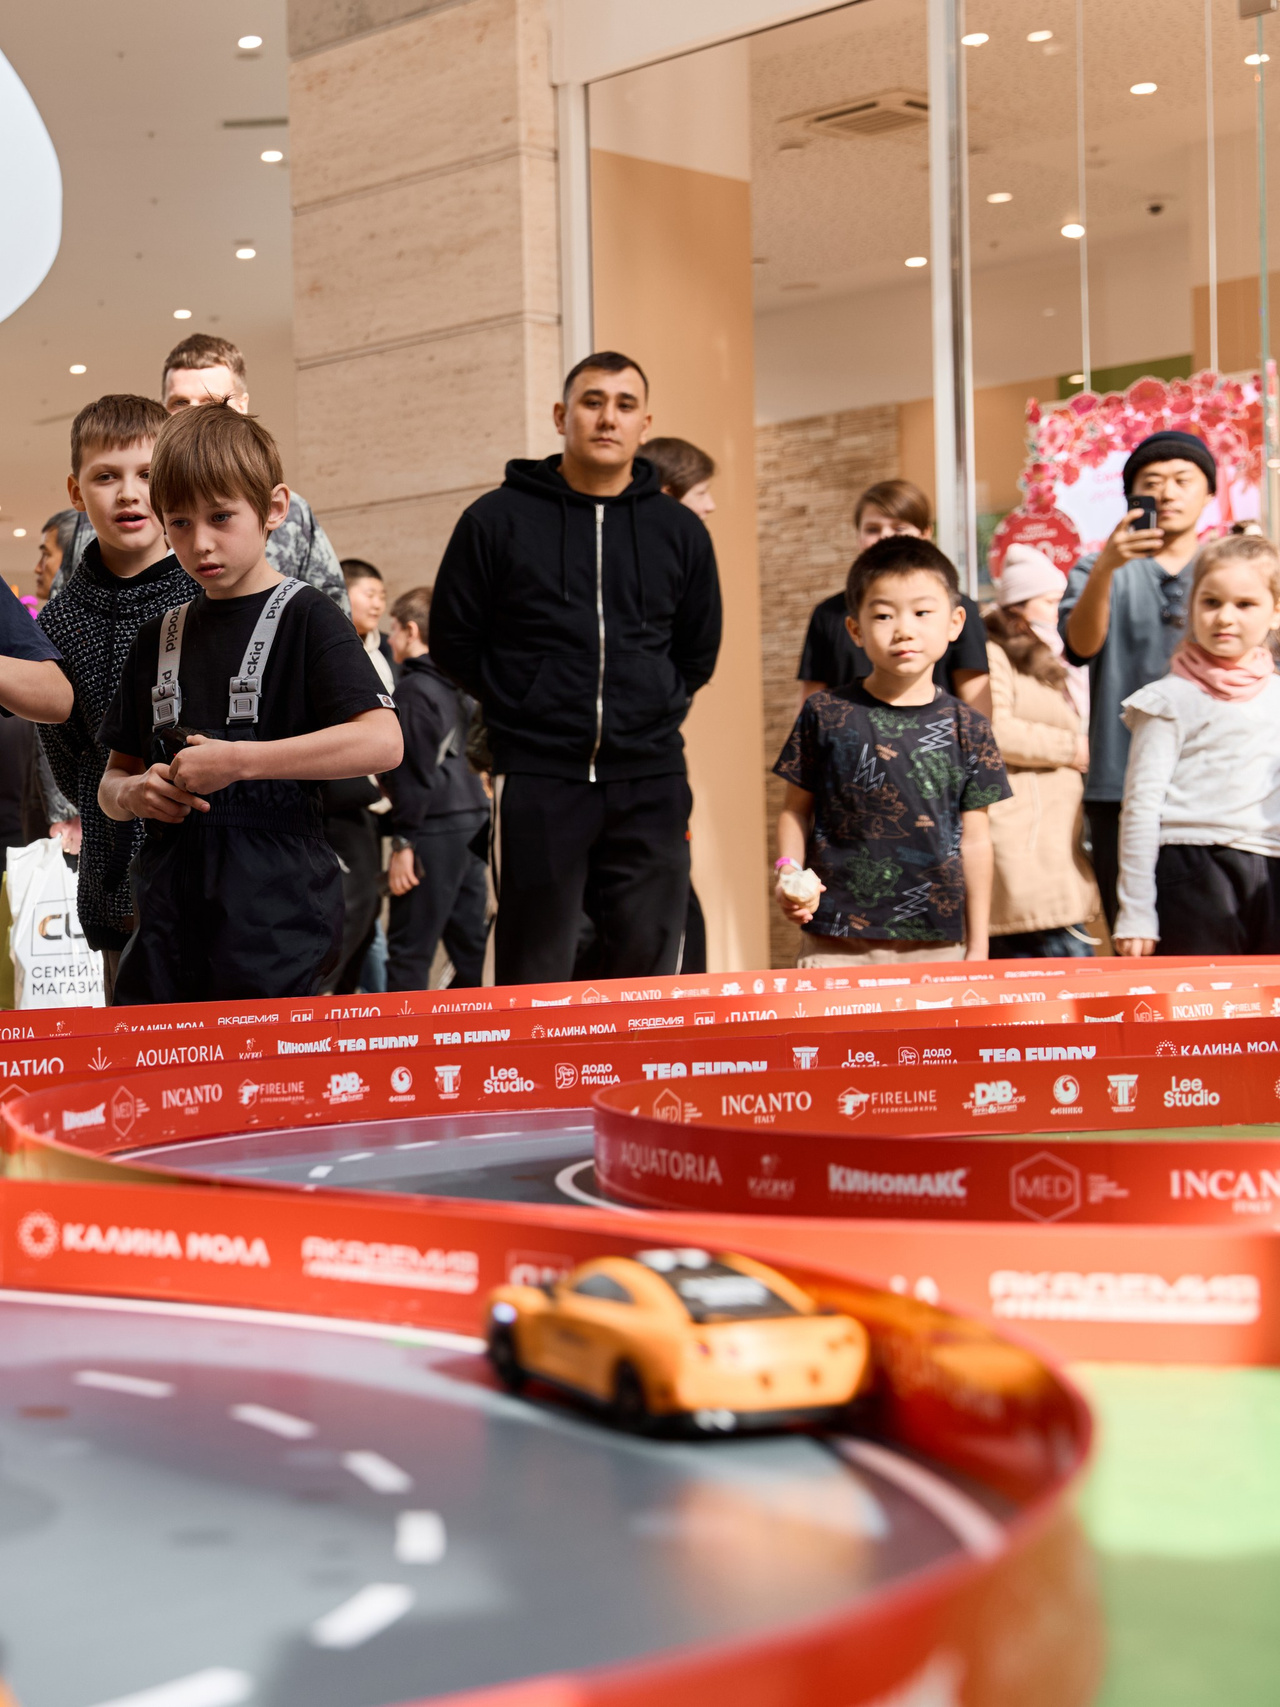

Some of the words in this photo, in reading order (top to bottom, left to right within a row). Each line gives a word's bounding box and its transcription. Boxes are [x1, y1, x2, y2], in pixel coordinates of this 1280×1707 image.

[620, 989, 662, 1002] INCANTO
[1172, 1003, 1214, 1019] INCANTO
[217, 1013, 279, 1026] АКАДЕМИЯ
[628, 1016, 685, 1028] АКАДЕМИЯ
[433, 1032, 462, 1045] TEA
[547, 1025, 588, 1038] КАЛИНА
[589, 1023, 617, 1034] МОЛЛ
[277, 1037, 332, 1055] КИНОМАКС
[337, 1038, 367, 1053] TEA
[922, 1048, 952, 1059] ДОДО
[1181, 1042, 1242, 1056] КАЛИНА
[1247, 1040, 1280, 1052] МОЛ
[847, 1048, 875, 1063] Lee
[979, 1048, 1021, 1062] TEA
[490, 1065, 518, 1079] Lee
[581, 1063, 613, 1075] ДОДО
[642, 1062, 687, 1080] TEA
[259, 1081, 305, 1095] FIRELINE
[483, 1077, 535, 1095] Studio
[581, 1074, 621, 1086] ПИЦЦА
[1171, 1076, 1203, 1092] Lee
[161, 1084, 223, 1109] INCANTO
[871, 1089, 937, 1105] FIRELINE
[974, 1080, 1013, 1106] DAB
[1164, 1090, 1220, 1108] Studio
[721, 1090, 812, 1116] INCANTO
[754, 1114, 776, 1124] ITALY
[620, 1142, 723, 1186] AQUATORIA
[828, 1163, 968, 1198] КИНОМАКС
[1020, 1174, 1074, 1200] MED
[1170, 1169, 1280, 1200] INCAN
[62, 1222, 182, 1260] КАЛИНА
[186, 1231, 271, 1268] МОЛЛ
